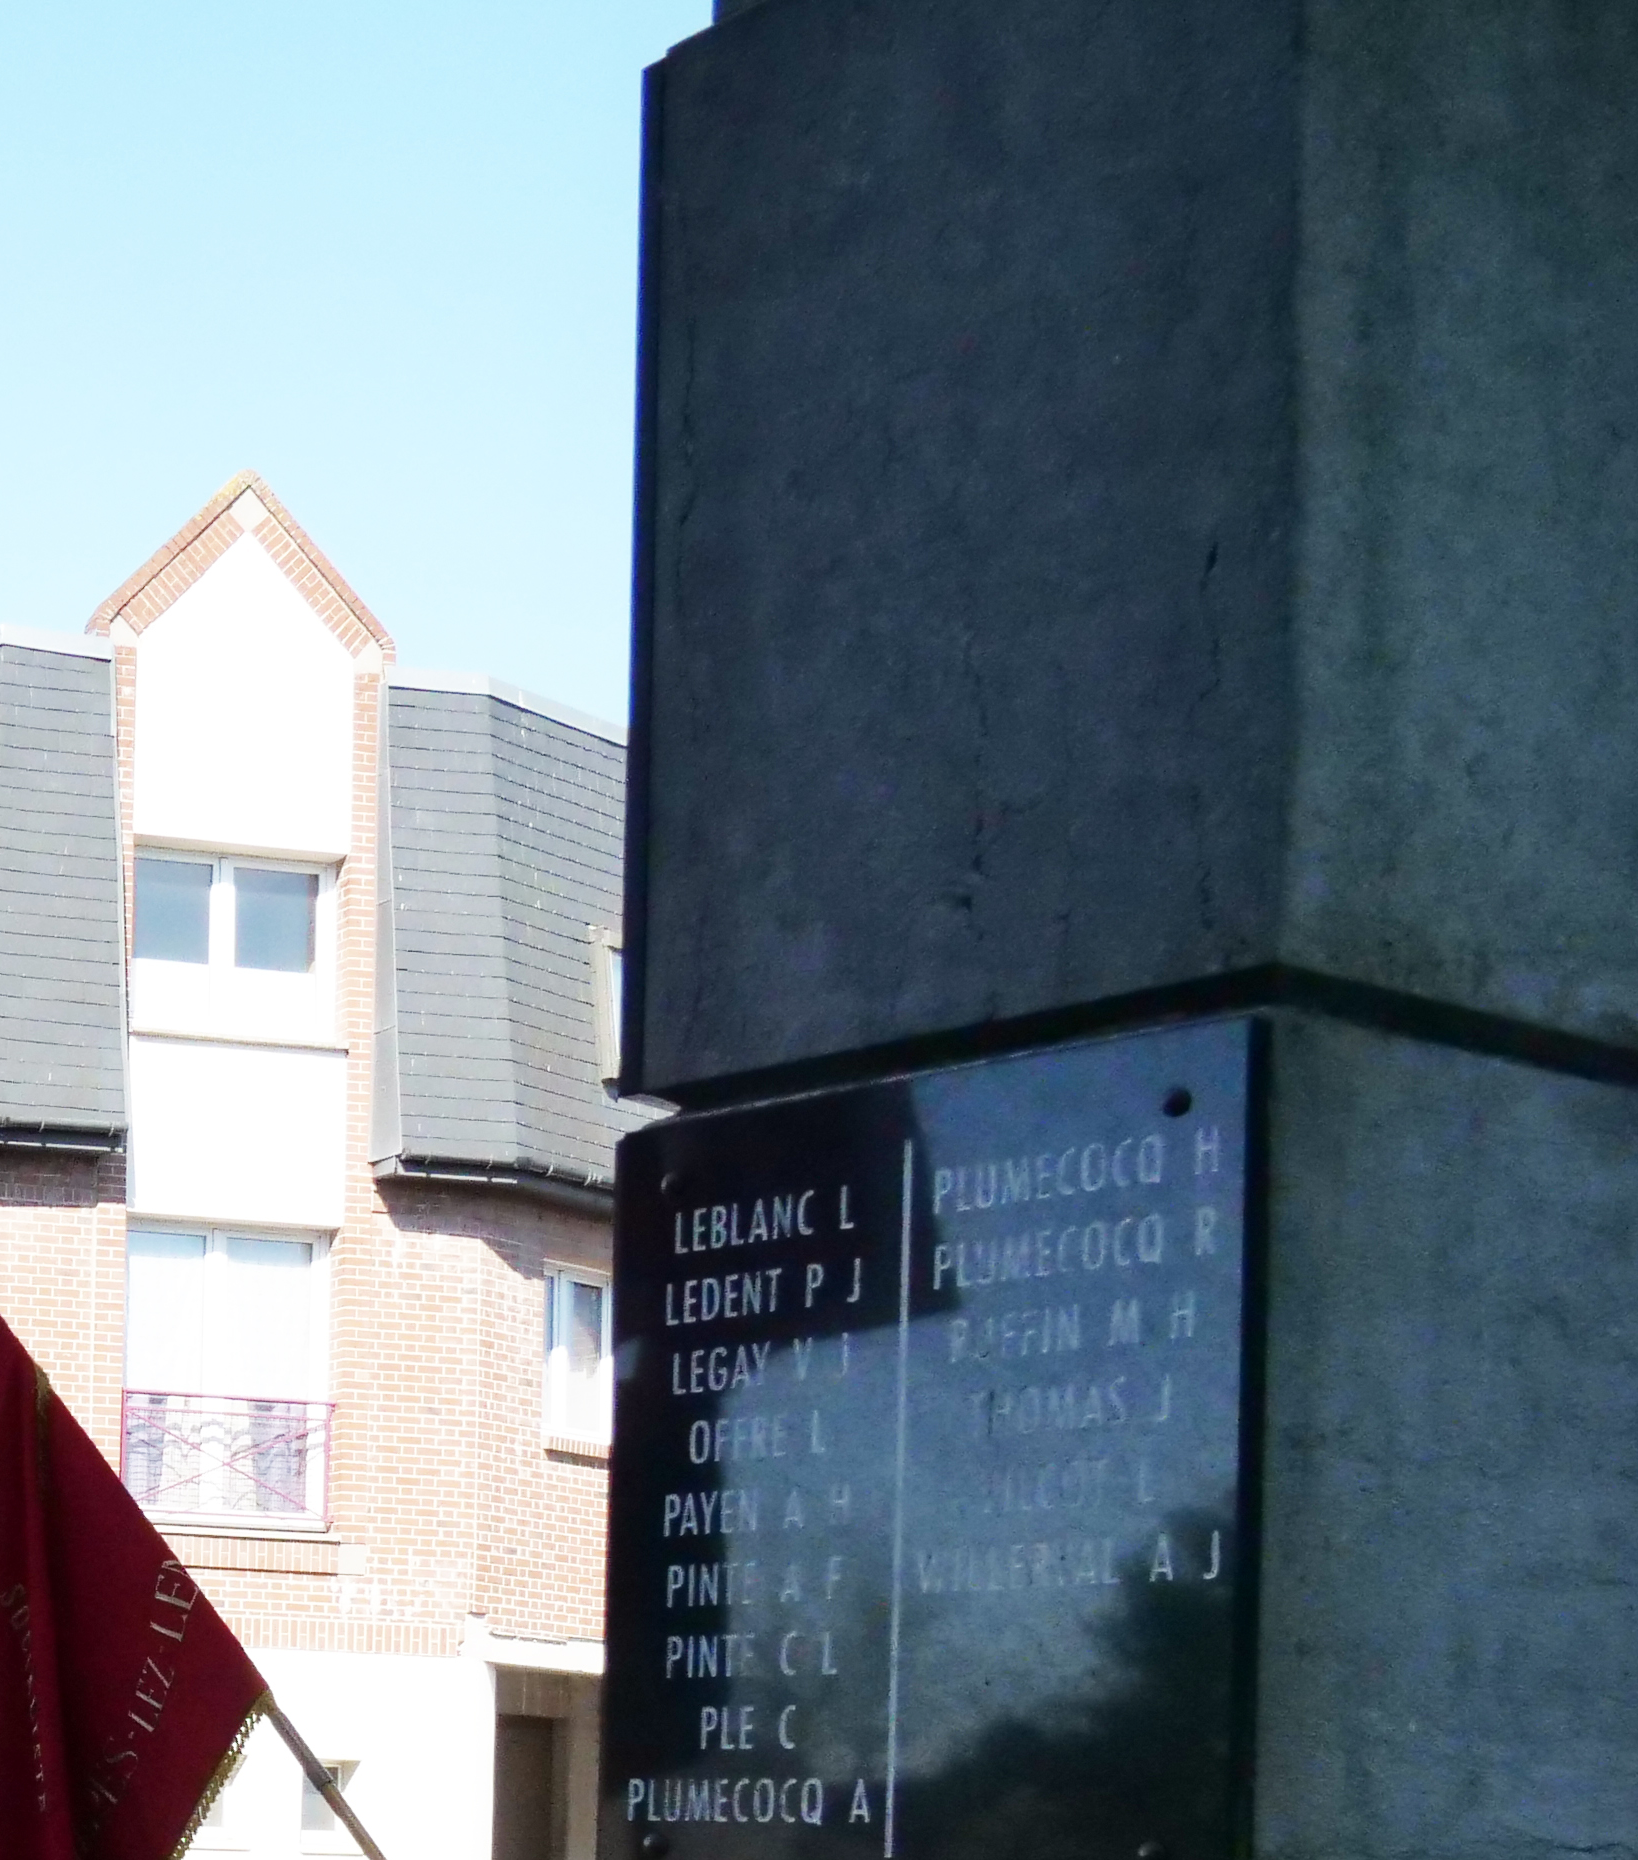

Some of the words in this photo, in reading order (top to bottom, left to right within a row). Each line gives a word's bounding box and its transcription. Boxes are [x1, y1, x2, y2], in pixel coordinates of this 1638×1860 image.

[933, 1133, 1165, 1215] PLUMECOCQ
[1194, 1127, 1221, 1176] H
[673, 1188, 817, 1256] LEBLANC
[838, 1185, 856, 1230] L
[933, 1212, 1165, 1290] PLUMECOCQ
[1194, 1206, 1219, 1257] R
[664, 1262, 782, 1327] LEDENT
[803, 1264, 825, 1309] P
[846, 1258, 862, 1303] J
[1107, 1296, 1142, 1348] M
[1169, 1290, 1198, 1340] H
[671, 1340, 771, 1396] LEGAY
[1152, 1373, 1173, 1424] J
[687, 1411, 788, 1466] OFFRE
[808, 1408, 828, 1455] L
[662, 1488, 759, 1538] PAYEN
[781, 1487, 806, 1530] A
[1148, 1531, 1175, 1583] A
[1201, 1528, 1223, 1582] J
[665, 1560, 758, 1609] PINTE
[778, 1562, 803, 1604] A
[664, 1633, 756, 1680] PINTE
[778, 1629, 798, 1677] C
[820, 1635, 840, 1677] L
[699, 1705, 756, 1751] PLE
[777, 1703, 798, 1750] C
[625, 1776, 825, 1826] PLUMECOCQ
[847, 1778, 872, 1825] A
